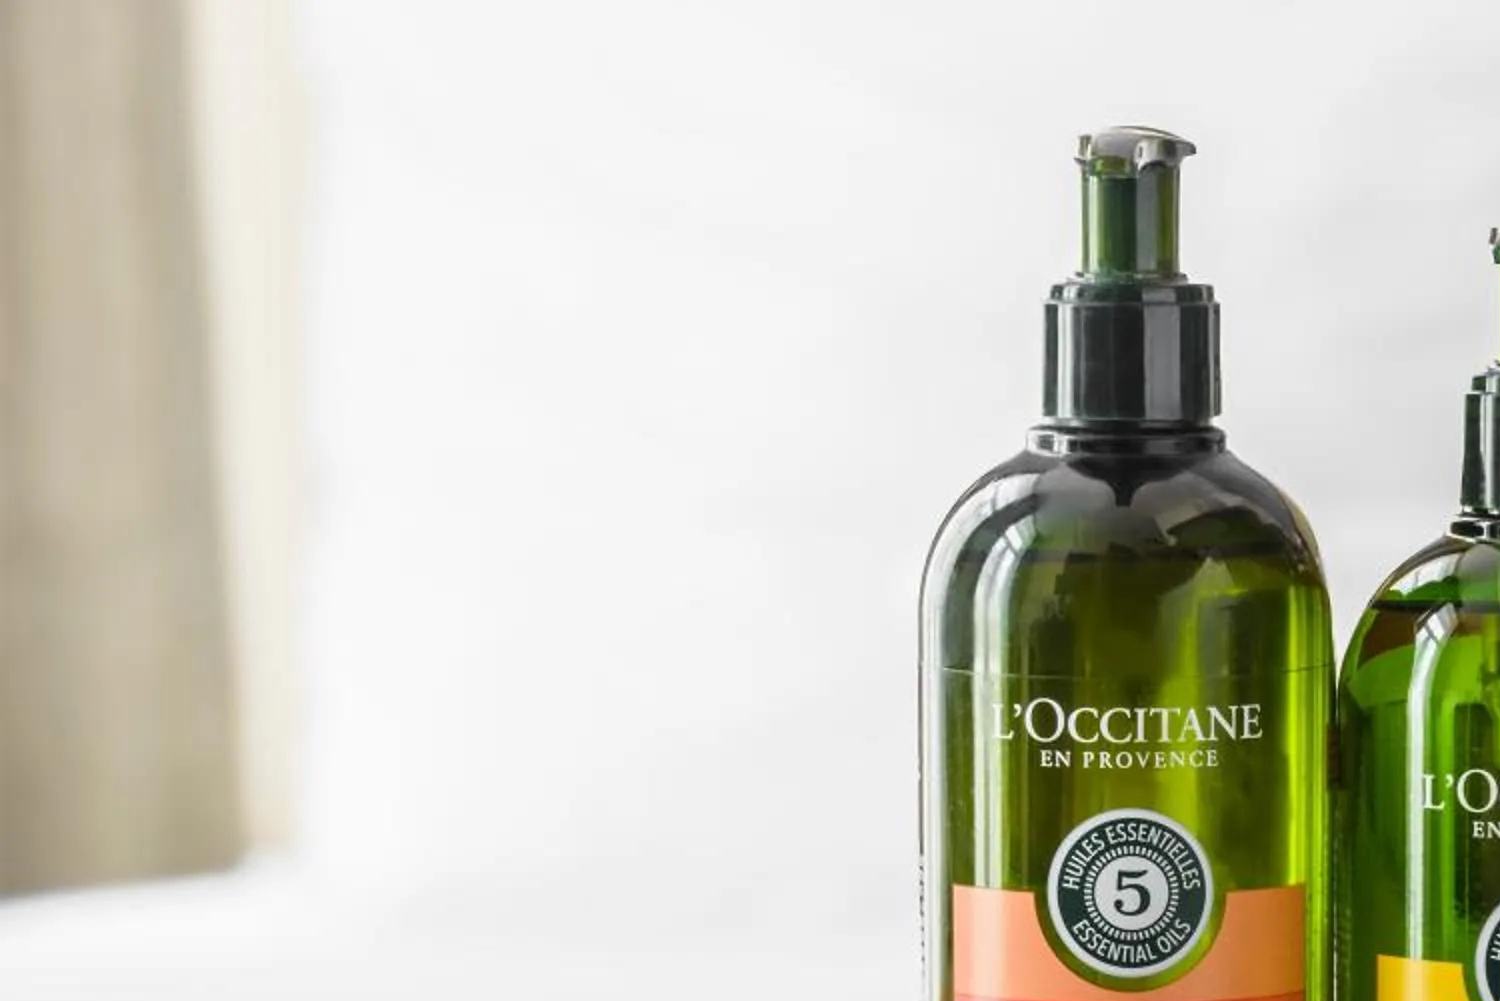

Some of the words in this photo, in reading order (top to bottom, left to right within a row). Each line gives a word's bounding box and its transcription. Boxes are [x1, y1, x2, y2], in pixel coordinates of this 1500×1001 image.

[991, 697, 1263, 743] L'OCCITANE
[1040, 749, 1071, 768] EN
[1083, 749, 1219, 769] PROVENCE
[1062, 832, 1105, 890] HUILES
[1105, 823, 1201, 891] ESSENTIELLES
[1113, 868, 1152, 917] 5
[1072, 918, 1157, 964] ESSENTIAL
[1156, 918, 1192, 953] OILS
